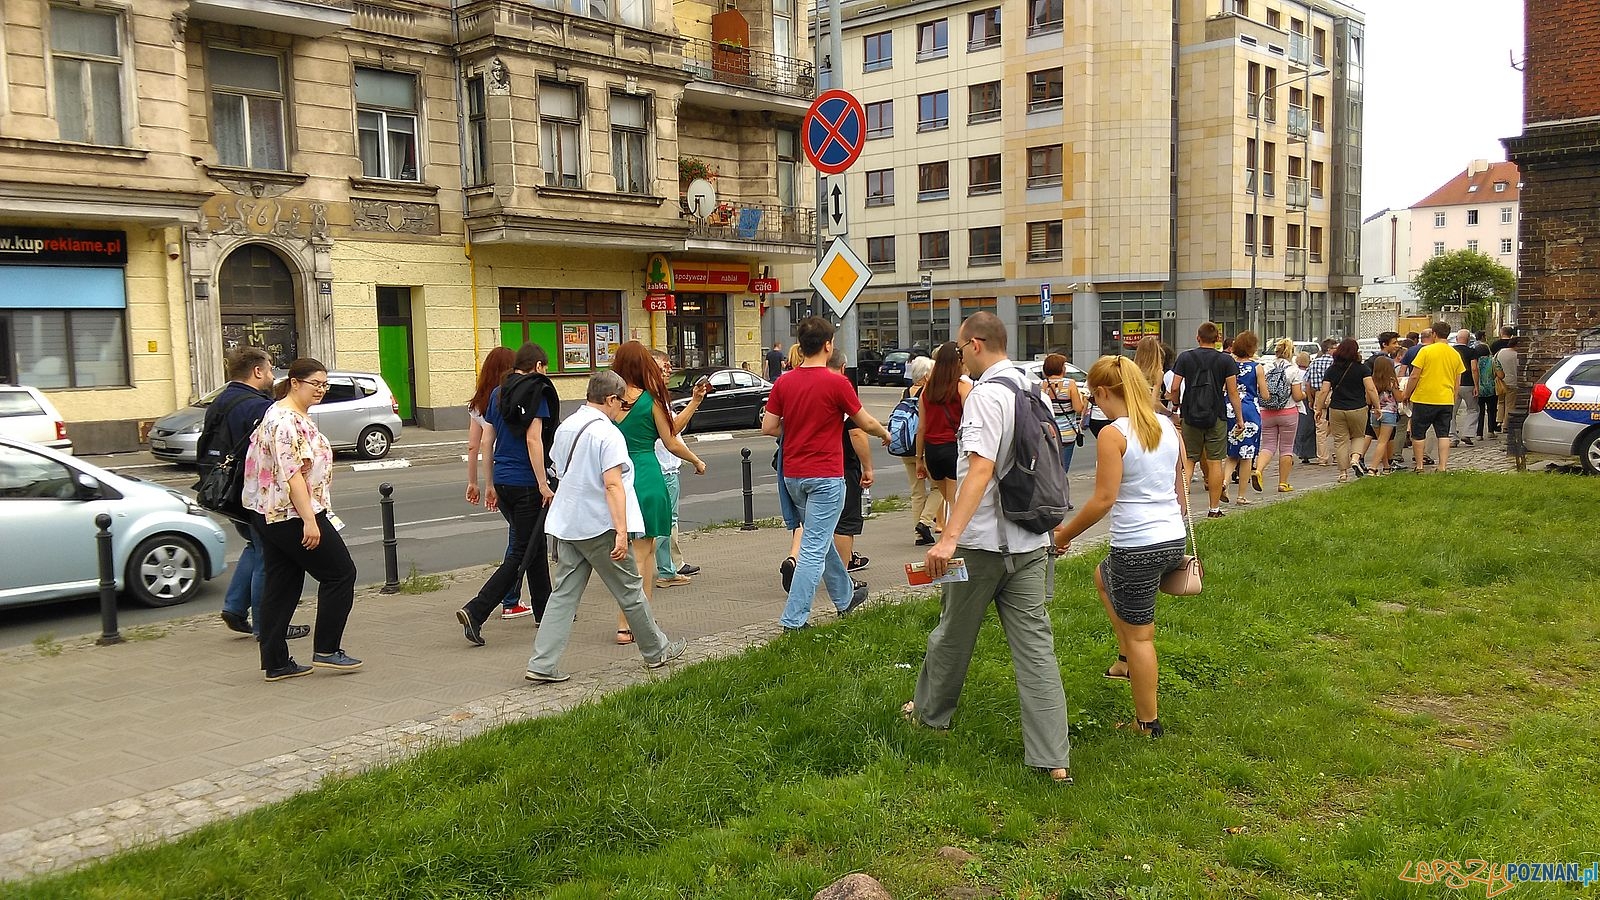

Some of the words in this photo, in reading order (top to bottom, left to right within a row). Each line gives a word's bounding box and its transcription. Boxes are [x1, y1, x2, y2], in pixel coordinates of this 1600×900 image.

[754, 282, 772, 291] café
[650, 301, 667, 310] 6-23
[1558, 388, 1573, 398] 06
[1591, 412, 1600, 420] te
